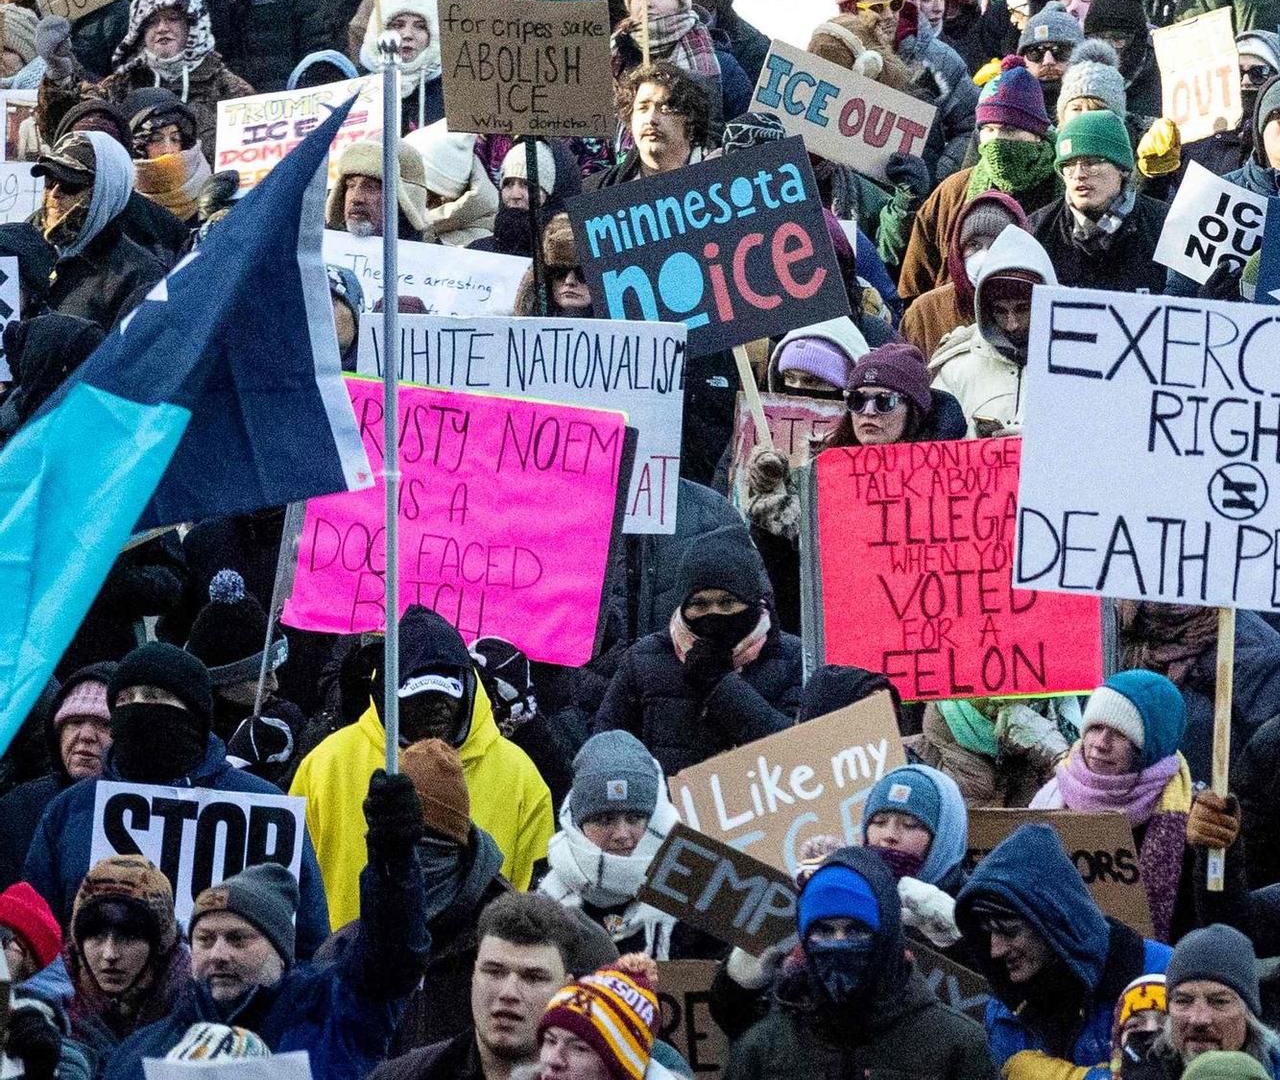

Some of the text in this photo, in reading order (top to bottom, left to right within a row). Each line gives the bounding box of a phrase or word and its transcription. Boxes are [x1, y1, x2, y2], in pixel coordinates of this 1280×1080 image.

[559, 14, 606, 38] sake
[452, 41, 583, 86] ABOLISH
[224, 90, 334, 127] TRUMP
[472, 114, 510, 135] Why
[495, 83, 550, 114] ICE
[757, 56, 929, 160] ICE OUT
[585, 163, 807, 261] minnesota
[601, 222, 828, 331] noice
[371, 326, 494, 389] WHITE
[496, 411, 621, 488] NOEM
[845, 446, 898, 475] YOU
[850, 467, 1002, 504] TALK ABOUT
[417, 532, 544, 592] FACED
[889, 546, 959, 575] WHEN
[1016, 506, 1211, 602] DEATH
[876, 570, 1037, 622] VOTED
[902, 618, 960, 650] FOR
[882, 640, 1046, 698] FELON
[711, 737, 889, 830] Like my
